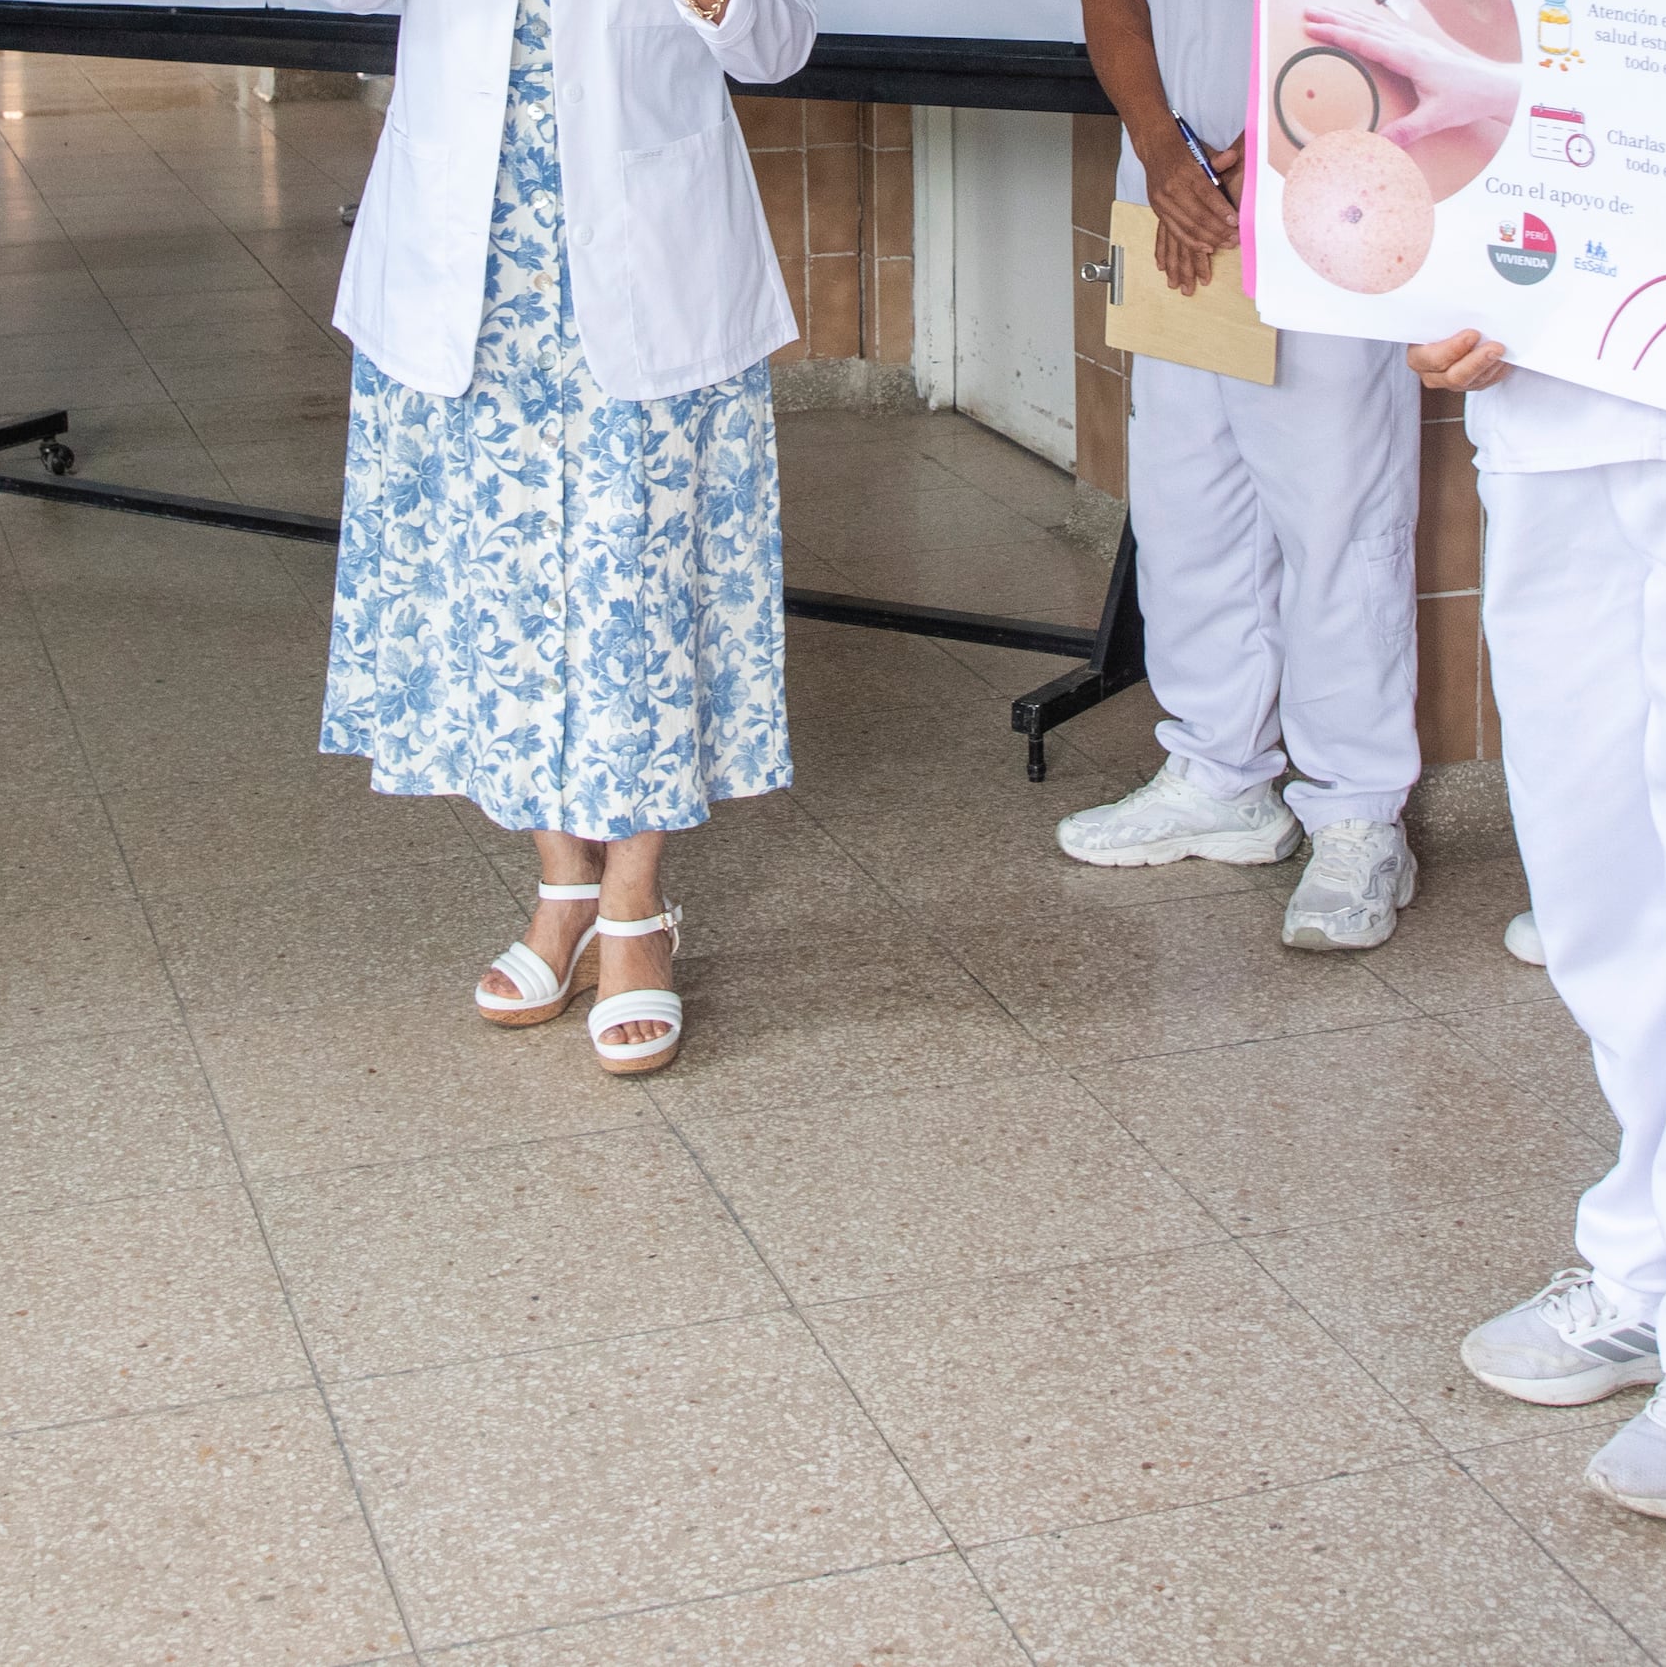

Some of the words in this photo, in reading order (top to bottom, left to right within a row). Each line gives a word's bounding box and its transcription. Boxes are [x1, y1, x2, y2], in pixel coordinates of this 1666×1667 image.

[1587, 3, 1658, 27] Atención
[1595, 27, 1637, 47] salud
[1625, 55, 1660, 73] todo
[1607, 128, 1666, 154] Charlas
[1626, 157, 1660, 176] todo
[1485, 176, 1523, 197] Con
[1528, 183, 1545, 200] el
[1549, 188, 1605, 211] apoyo
[1608, 195, 1634, 215] de:
[1524, 229, 1548, 241] PERÚ
[1495, 252, 1549, 270] VIVIENDA
[1574, 256, 1617, 277] EsSalud
